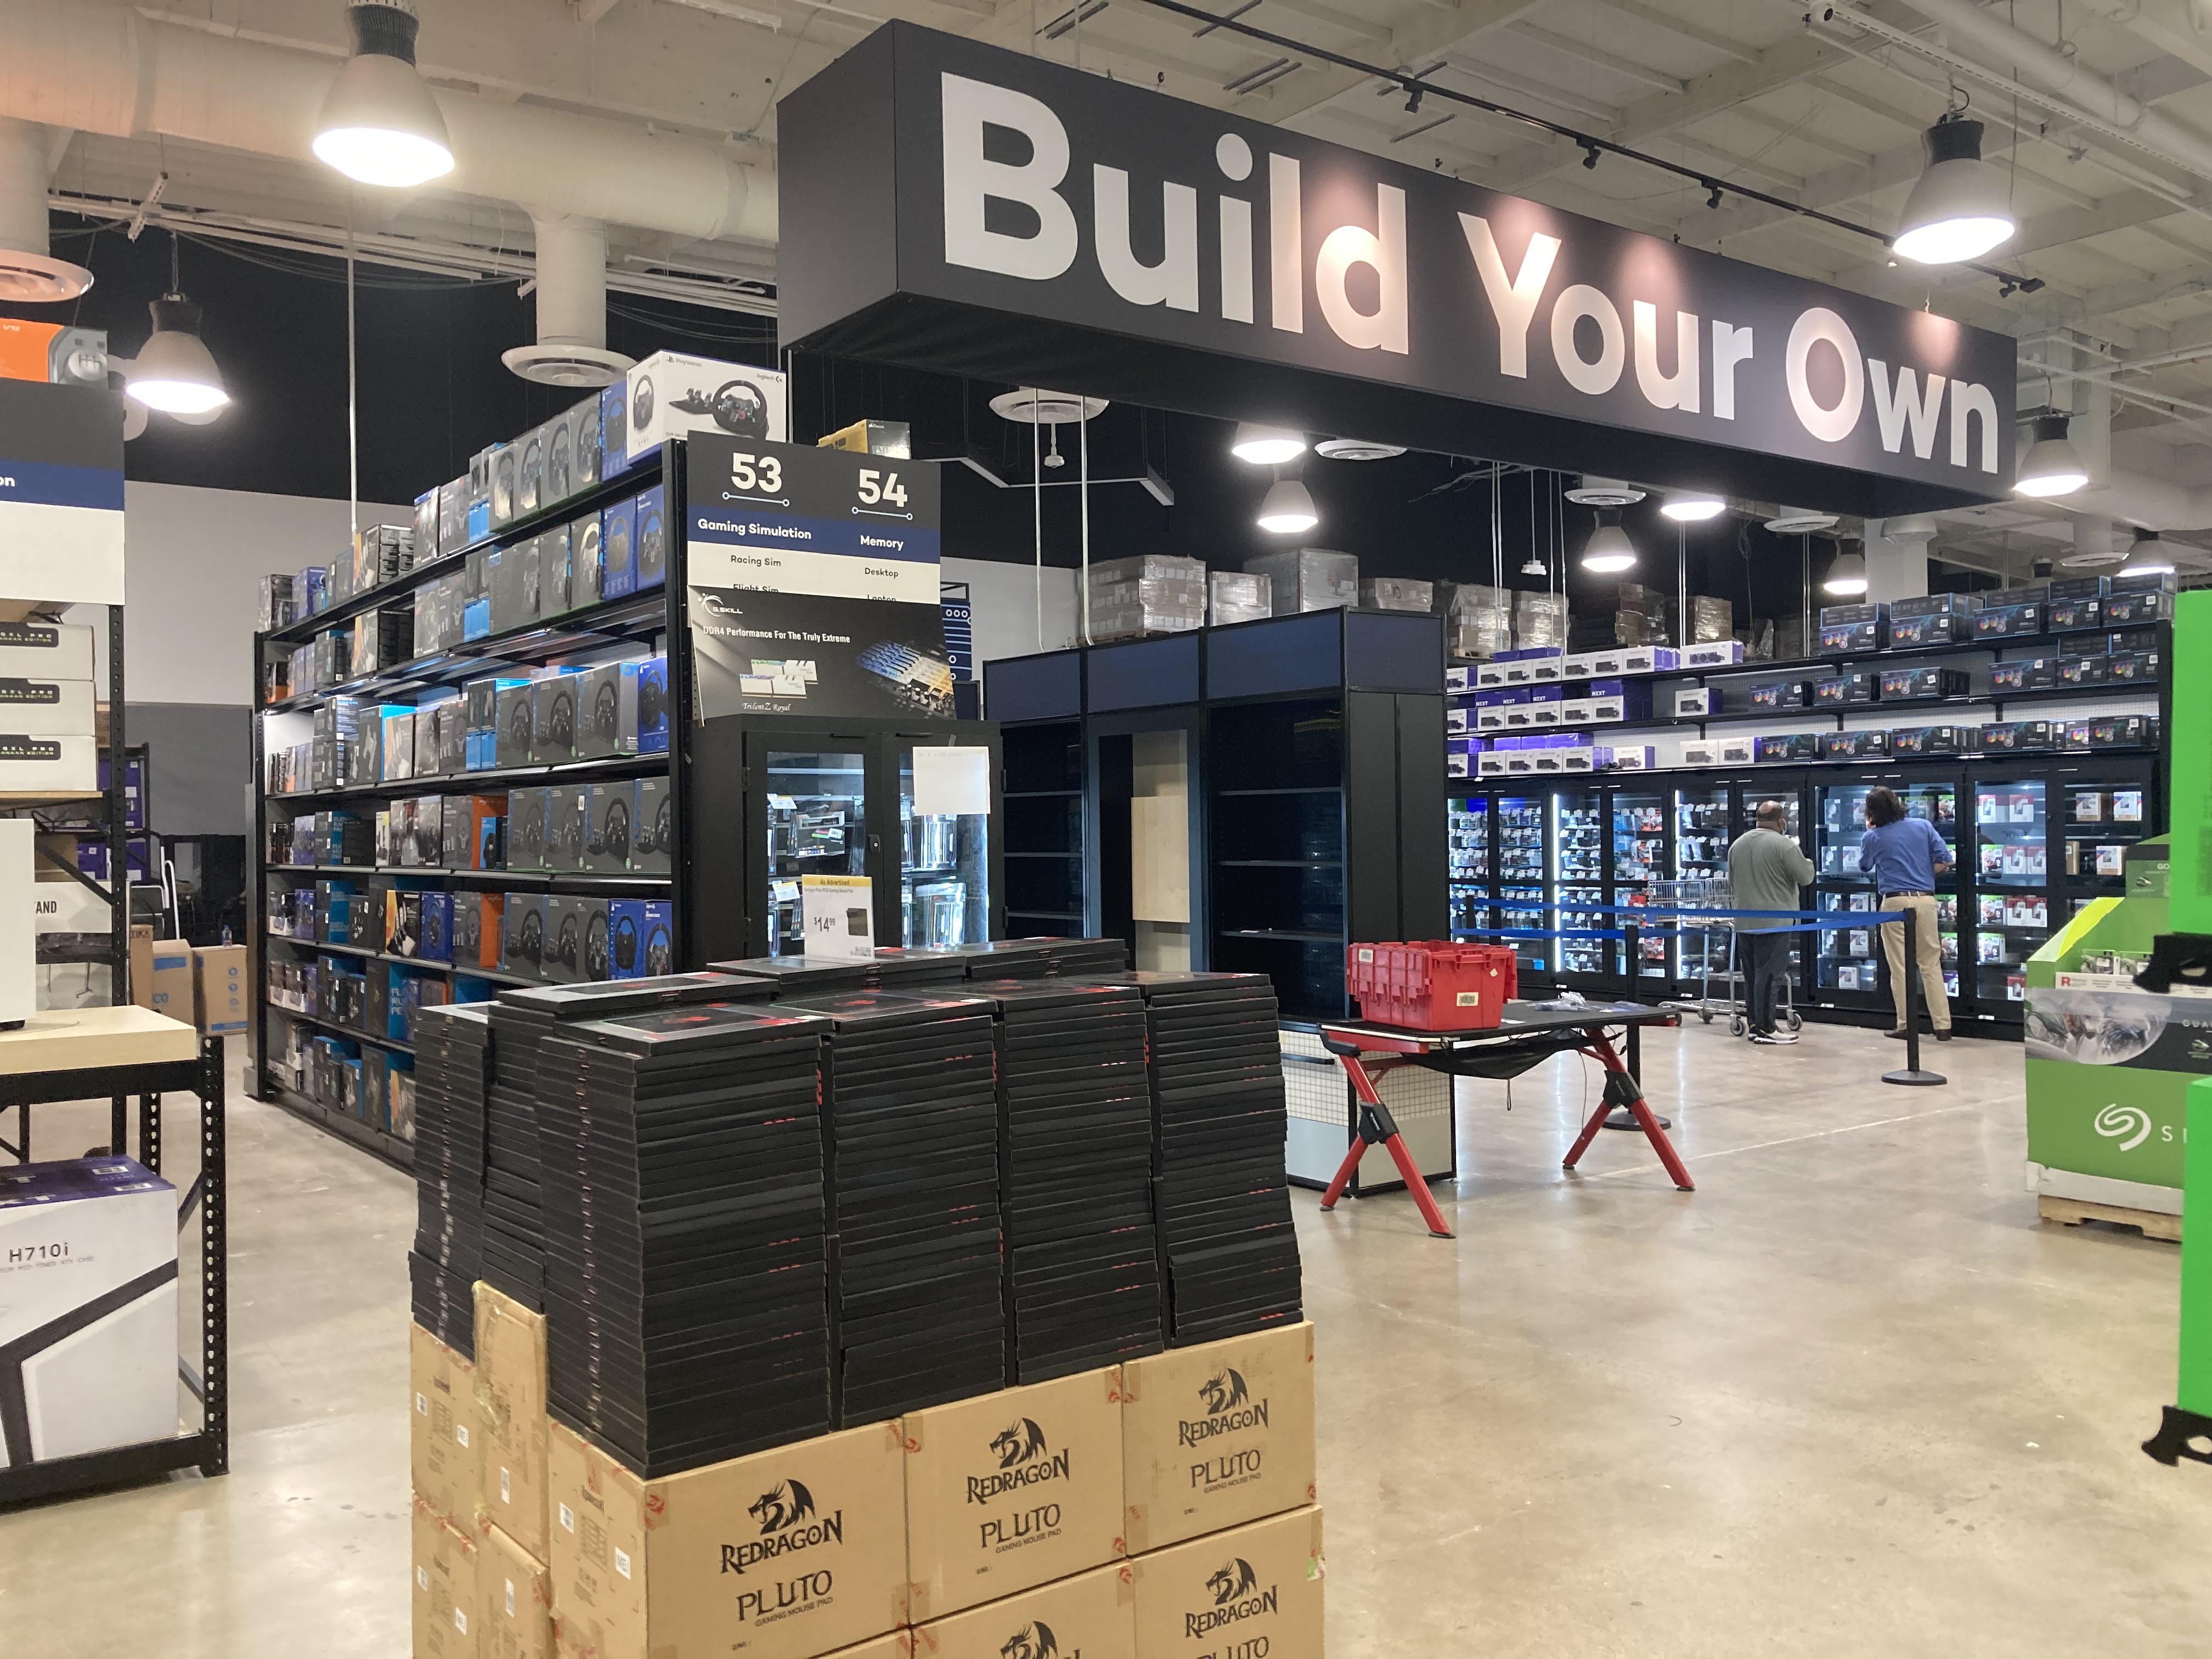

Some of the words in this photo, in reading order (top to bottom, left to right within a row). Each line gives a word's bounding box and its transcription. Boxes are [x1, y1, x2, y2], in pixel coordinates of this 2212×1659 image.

[940, 71, 1409, 357] Build
[1457, 212, 1754, 421] Your
[1785, 305, 2000, 476] Own
[675, 358, 702, 368] PlayStation
[731, 452, 783, 494] 53
[857, 468, 909, 509] 54
[697, 517, 746, 537] Gaming
[748, 523, 812, 540] Simulation
[860, 534, 904, 552] Memory
[731, 555, 762, 567] Racing
[764, 557, 782, 567] Sim
[864, 567, 899, 579] Desktop
[712, 606, 743, 614] G.SKILL
[703, 625, 725, 636] DDR4
[726, 627, 773, 639] Performance
[774, 630, 786, 640] For
[787, 631, 802, 640] The
[802, 632, 821, 643] Truly
[821, 633, 851, 644] Extreme
[772, 703, 792, 713] Royal
[35, 900, 57, 914] AND
[2182, 1019, 2212, 1028] GUA
[2161, 1125, 2188, 1144] S
[9, 1242, 69, 1263] H710i
[18, 1260, 57, 1271] MID-TOWER
[77, 1255, 95, 1263] CASE
[1178, 1397, 1269, 1448] REDRAGON
[966, 1447, 1070, 1505] REDRAGON
[1190, 1449, 1262, 1489] PLUTO
[1228, 1476, 1249, 1488] MOUSE
[1249, 1472, 1262, 1482] PAD
[979, 1503, 1062, 1549] PLUTO
[719, 1509, 844, 1575] REDRAGON
[995, 1539, 1023, 1555] GAMING
[1023, 1531, 1046, 1546] MOUSE
[1047, 1527, 1062, 1539] PAD
[735, 1569, 834, 1622] PLUTO
[754, 1611, 787, 1627] GAMING
[788, 1604, 816, 1618] MOUSE
[816, 1596, 834, 1608] PAD
[1184, 1584, 1279, 1639] REDRAGON
